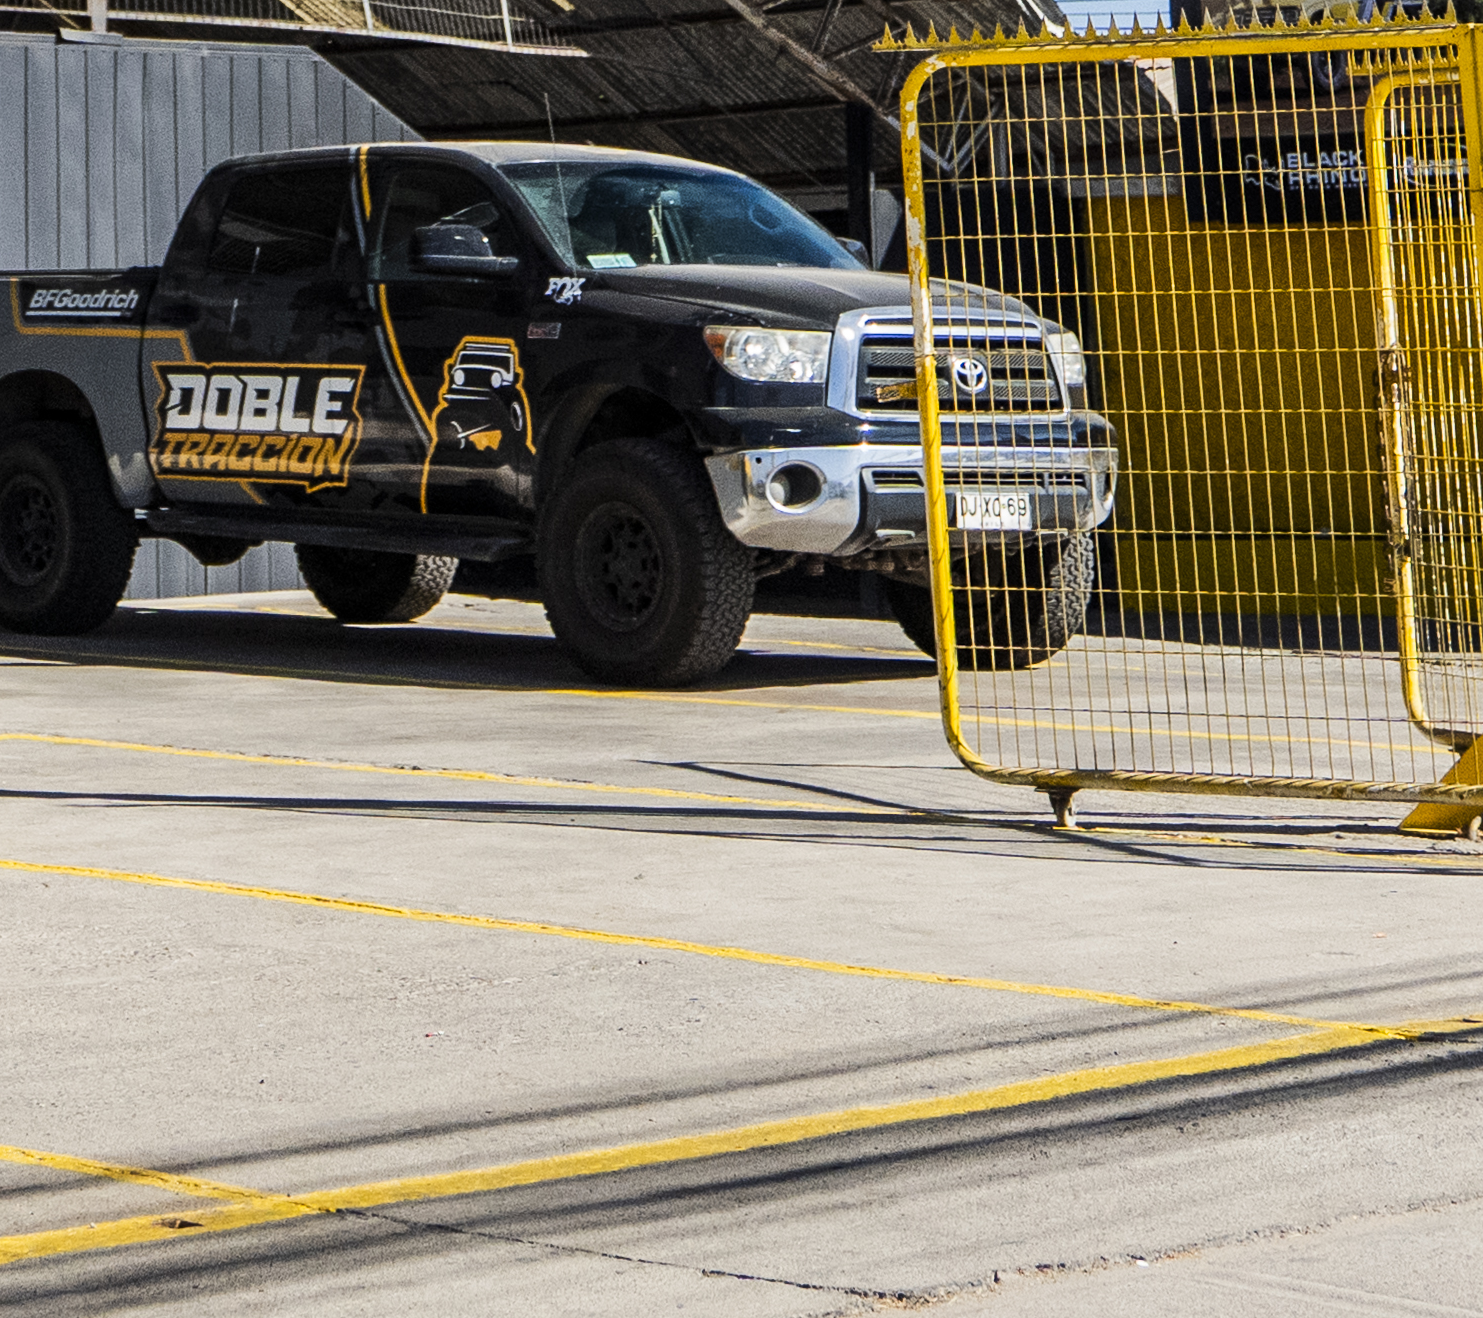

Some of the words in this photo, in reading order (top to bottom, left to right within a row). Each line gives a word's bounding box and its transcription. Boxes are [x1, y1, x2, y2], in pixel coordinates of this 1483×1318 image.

[1286, 150, 1364, 168] BLACK
[29, 288, 139, 309] BFGoodrich
[544, 276, 587, 306] FOX
[164, 373, 356, 435] DOBLE
